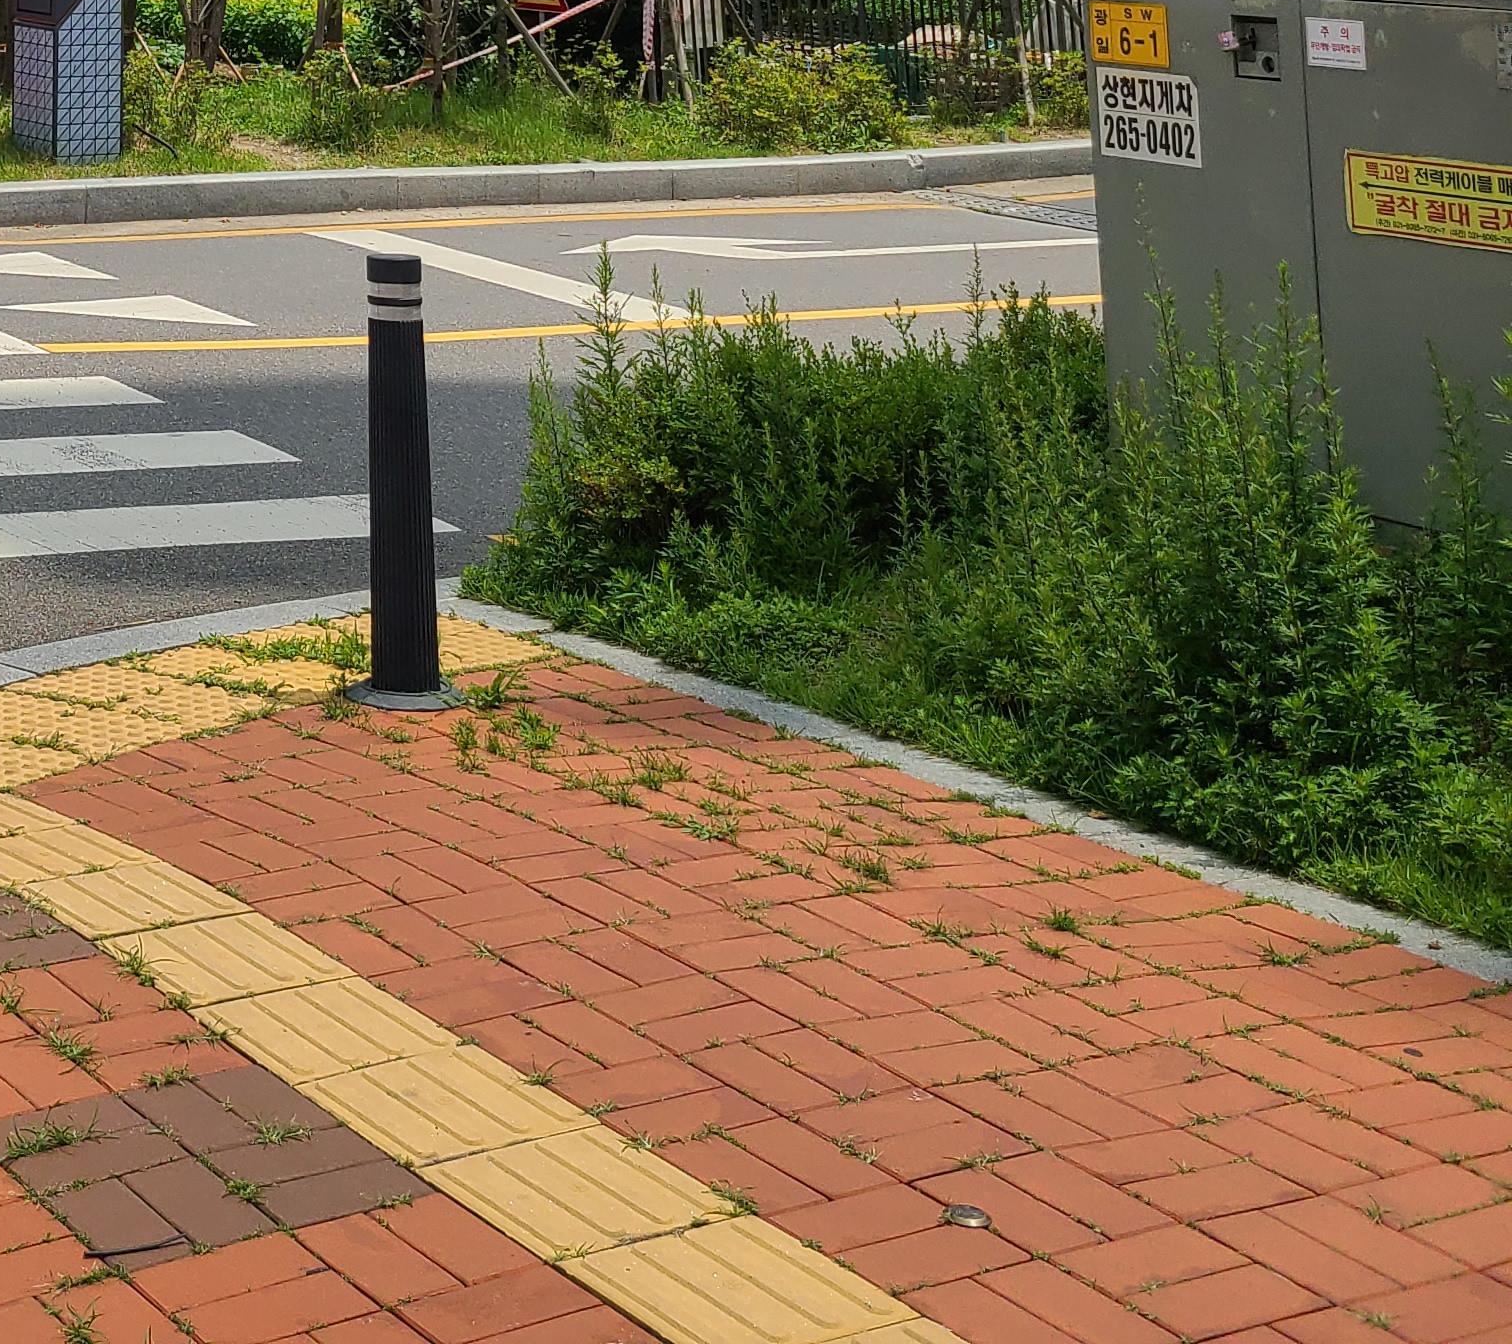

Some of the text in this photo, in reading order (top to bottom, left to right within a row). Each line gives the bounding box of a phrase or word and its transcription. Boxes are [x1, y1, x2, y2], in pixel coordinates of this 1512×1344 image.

[1120, 26, 1158, 58] 6-1
[1102, 75, 1193, 117] 상현지게차
[1104, 114, 1196, 159] 265-0402
[1414, 167, 1493, 194] 전력케이블
[1424, 199, 1471, 227] 절대
